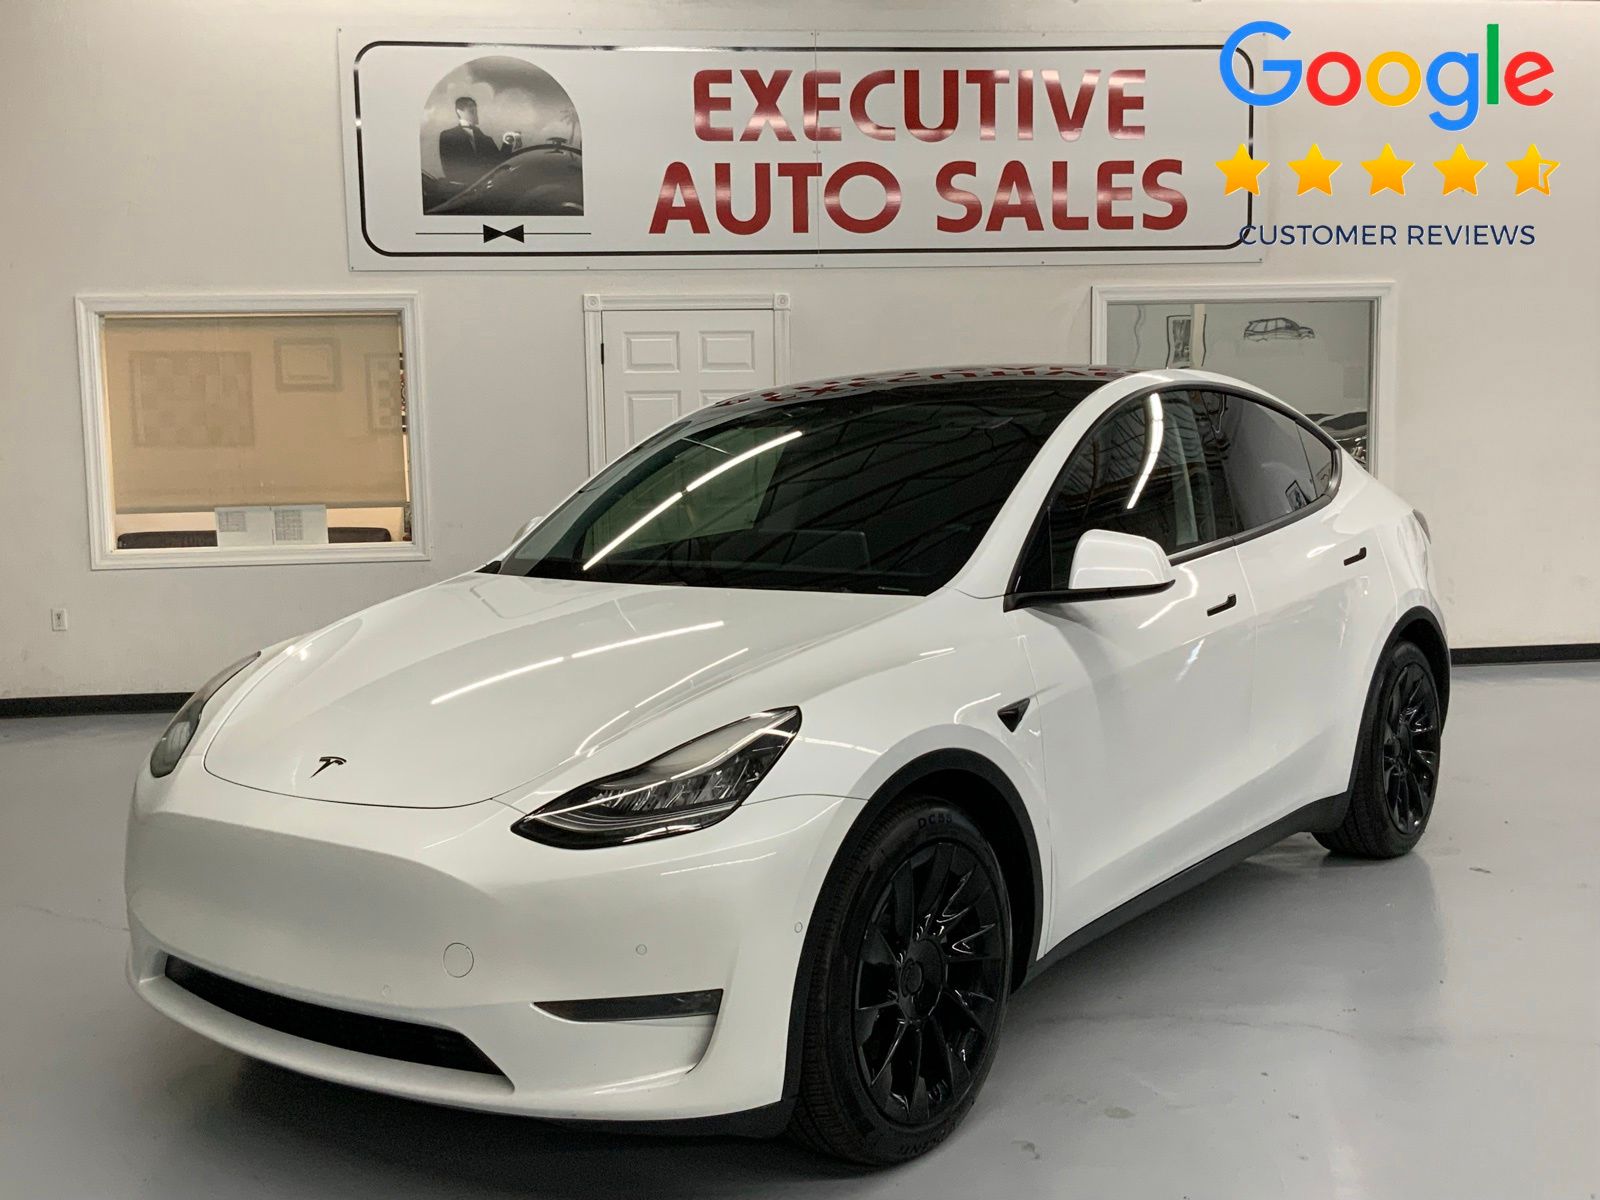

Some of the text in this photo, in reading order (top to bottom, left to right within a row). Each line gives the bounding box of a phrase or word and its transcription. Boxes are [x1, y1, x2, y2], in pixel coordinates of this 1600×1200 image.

[693, 68, 1147, 142] EXECUTIVE
[648, 159, 1189, 236] AUTO SALES
